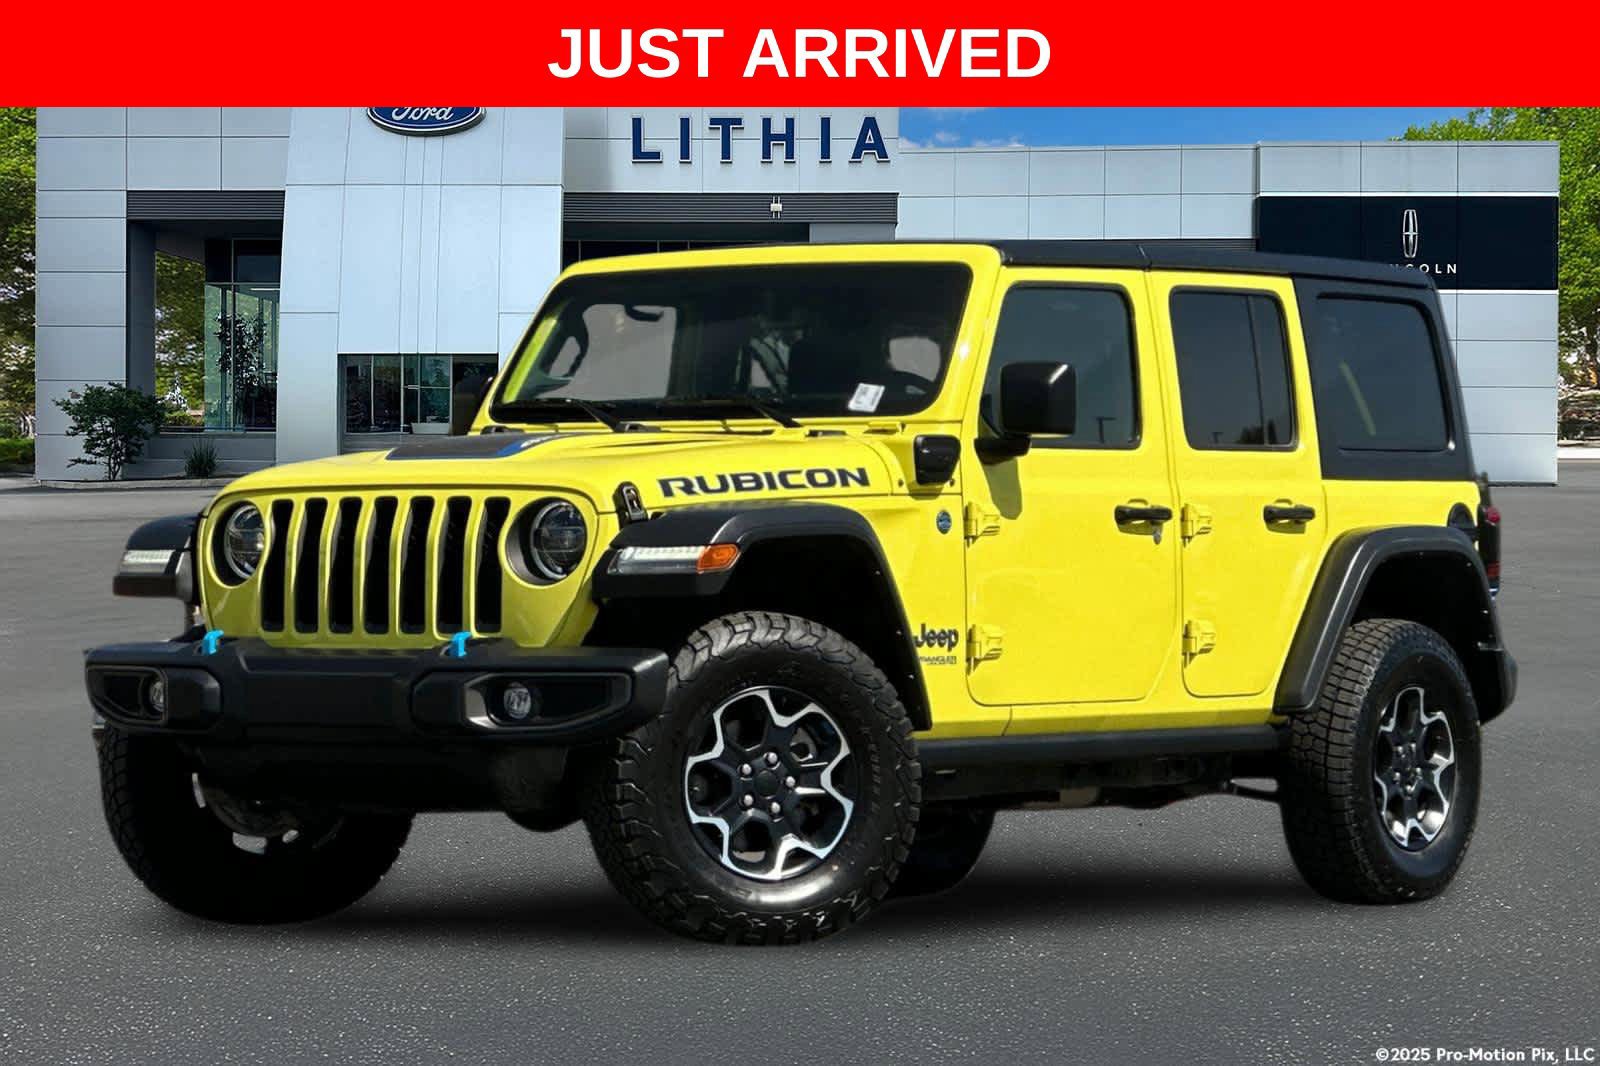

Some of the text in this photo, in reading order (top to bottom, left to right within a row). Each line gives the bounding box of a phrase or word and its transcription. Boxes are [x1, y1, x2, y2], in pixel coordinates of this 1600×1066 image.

[631, 115, 891, 163] LITHIA
[657, 467, 870, 498] RUBICON
[913, 622, 959, 652] Jeep
